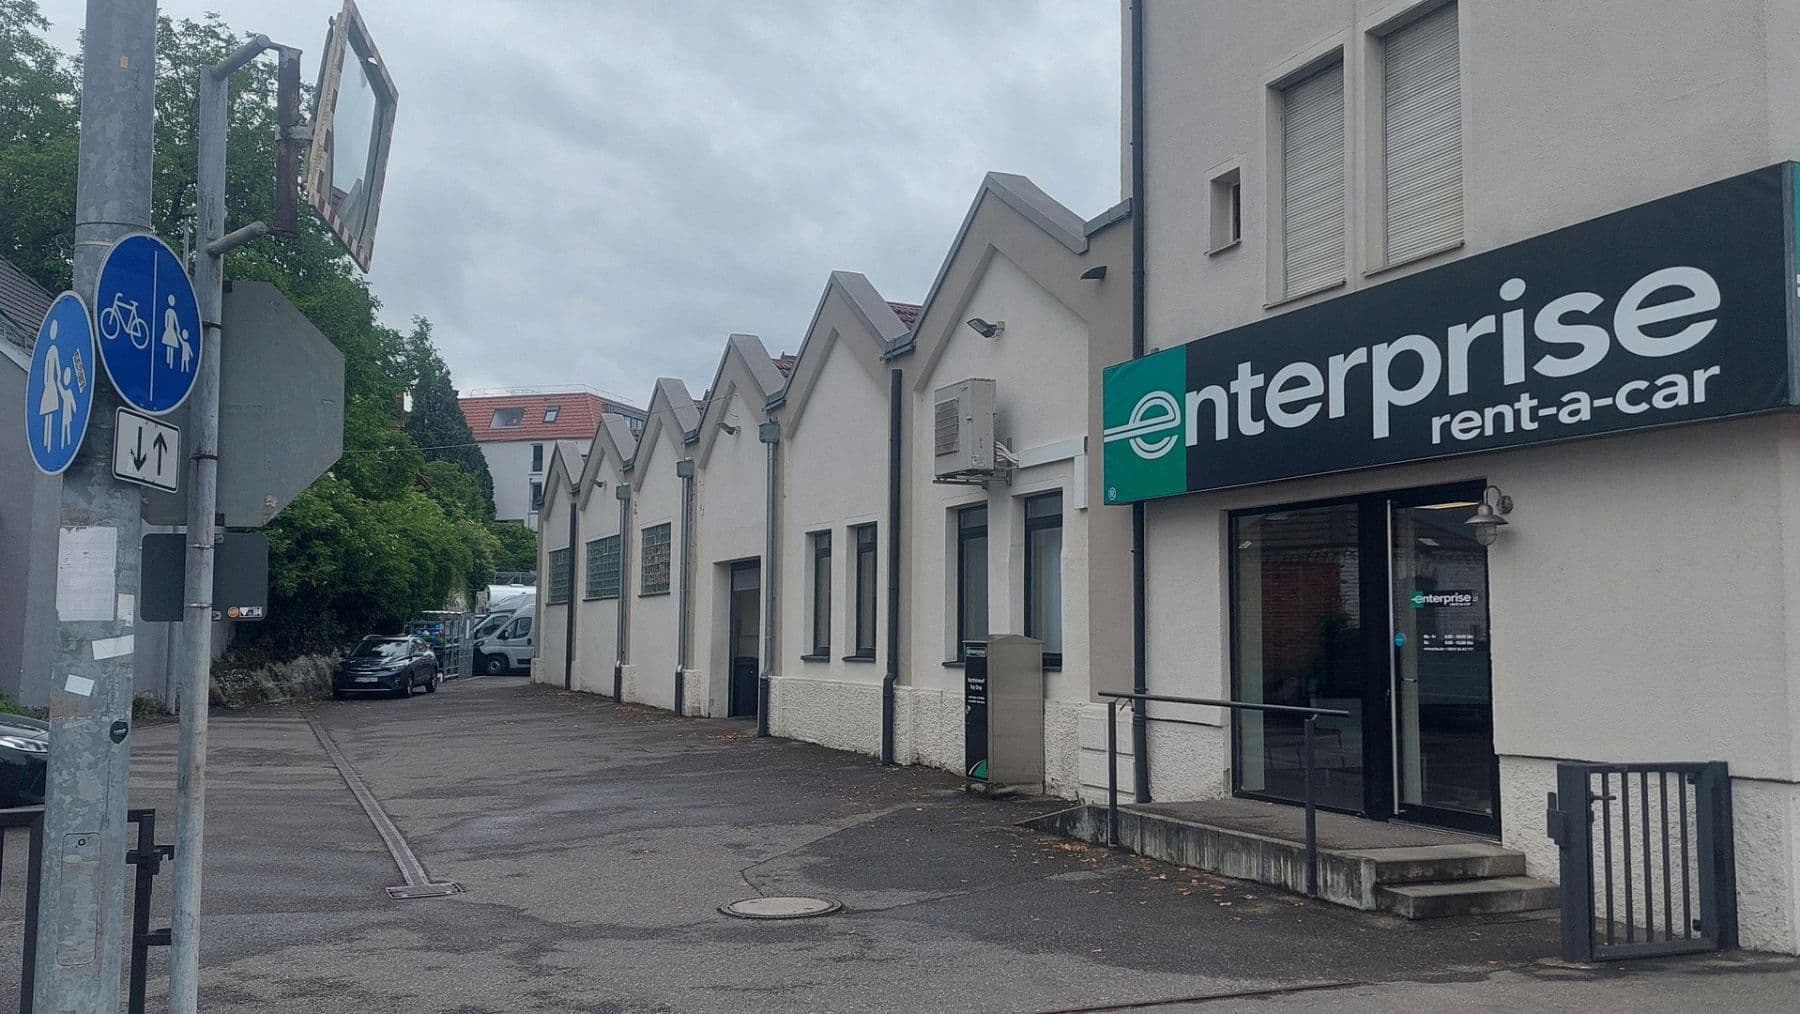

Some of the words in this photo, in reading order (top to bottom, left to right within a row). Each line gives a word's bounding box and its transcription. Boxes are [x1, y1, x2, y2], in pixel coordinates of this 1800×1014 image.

[1104, 266, 1722, 459] enterprise
[1431, 365, 1721, 444] rent-a-car
[1411, 592, 1472, 606] enterprise
